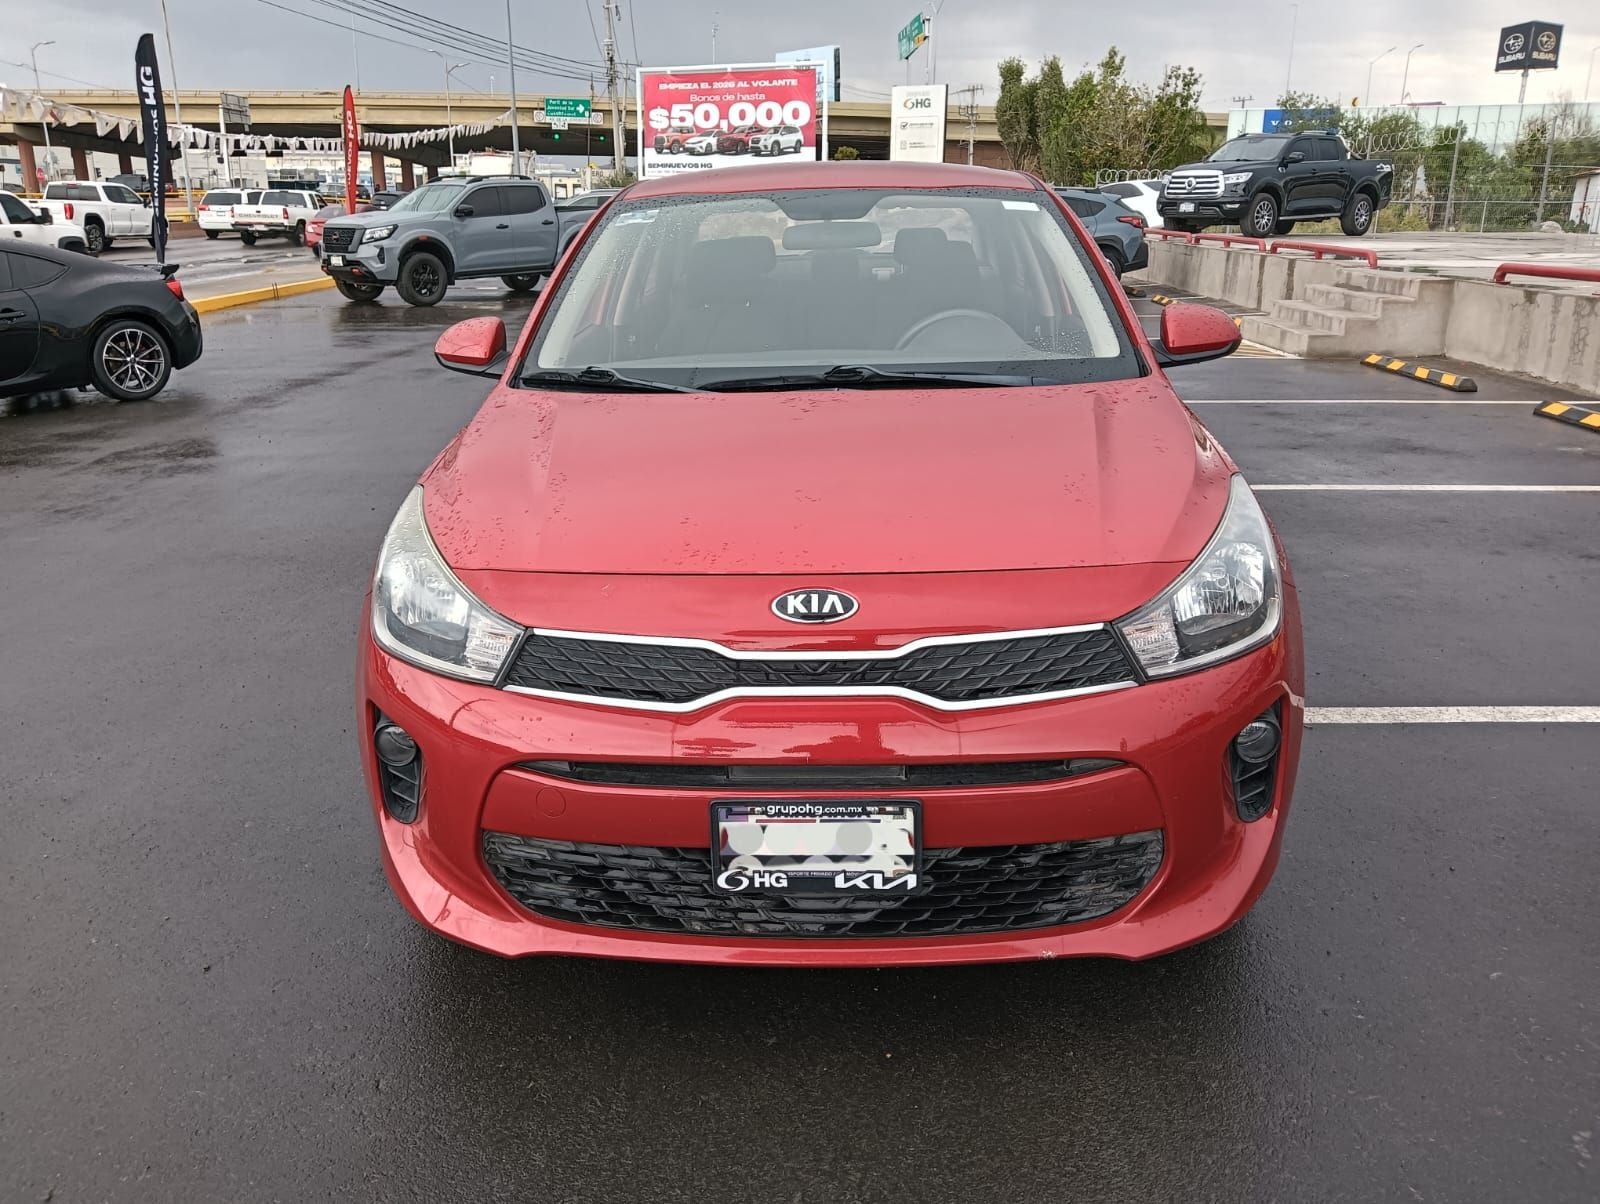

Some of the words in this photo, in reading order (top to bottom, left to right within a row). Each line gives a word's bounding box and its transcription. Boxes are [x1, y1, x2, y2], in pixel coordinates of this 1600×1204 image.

[1499, 52, 1526, 64] SUBARU
[1532, 51, 1557, 61] SUBARU
[140, 66, 157, 105] HG
[659, 82, 699, 91] EMPIEZA
[701, 82, 711, 90] EL
[712, 81, 737, 89] 2026
[737, 80, 750, 88] AL
[752, 79, 798, 87] VOLANTE
[690, 94, 720, 102] Bonos
[722, 93, 735, 101] de
[737, 92, 765, 101] hasta
[915, 97, 931, 109] HG
[649, 100, 811, 132] $50,000
[787, 593, 845, 614] KIA
[767, 804, 863, 815] grupohg.com.mx
[753, 872, 788, 888] HG
[835, 873, 917, 890] KIA
